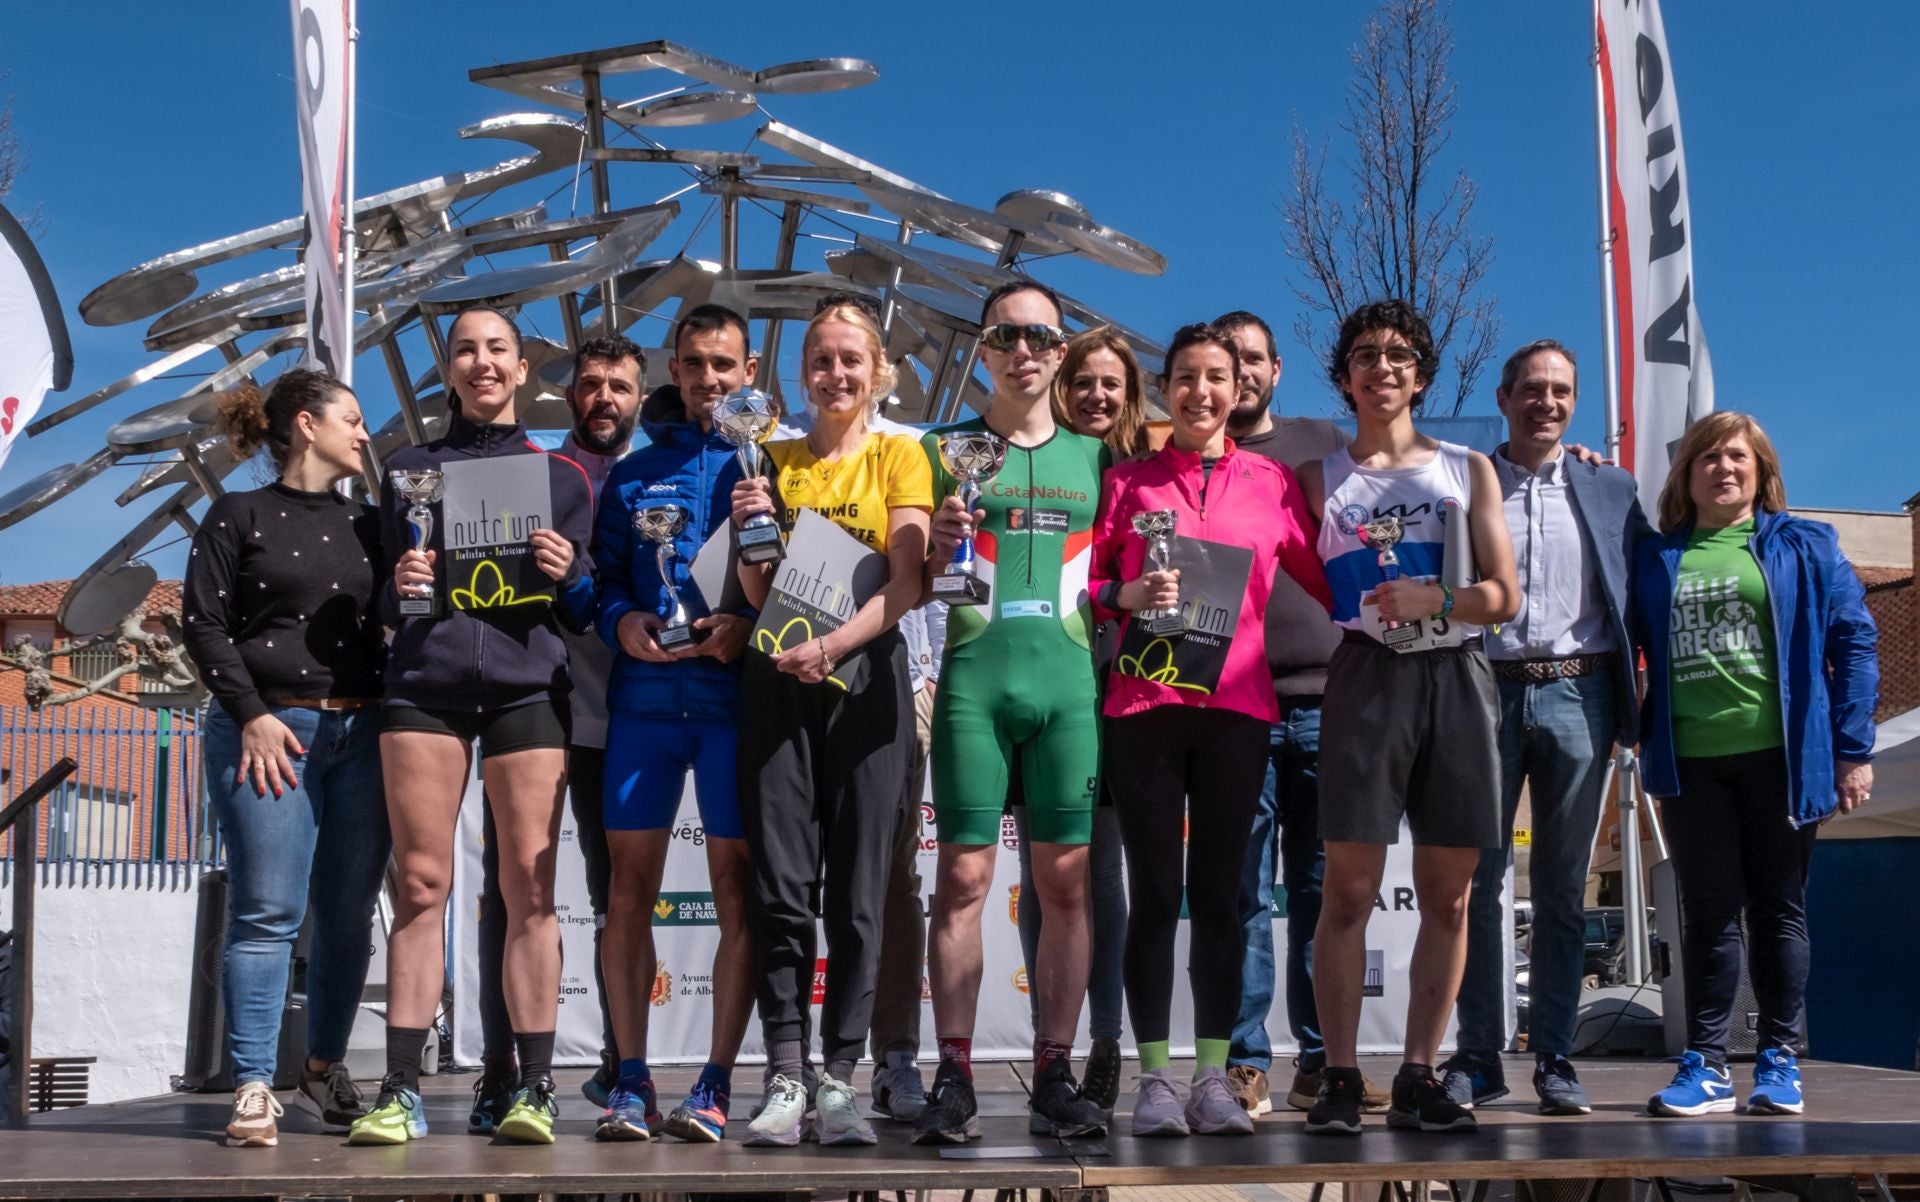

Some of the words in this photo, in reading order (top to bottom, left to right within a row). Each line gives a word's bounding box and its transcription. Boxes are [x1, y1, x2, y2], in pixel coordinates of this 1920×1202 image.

[991, 483, 1087, 502] CataNatura
[1675, 576, 1739, 606] ALLE
[1669, 603, 1711, 632] DEL
[1669, 623, 1763, 659] IREGUA
[679, 902, 703, 911] CAJA
[679, 911, 692, 919] DE
[681, 986, 693, 996] de
